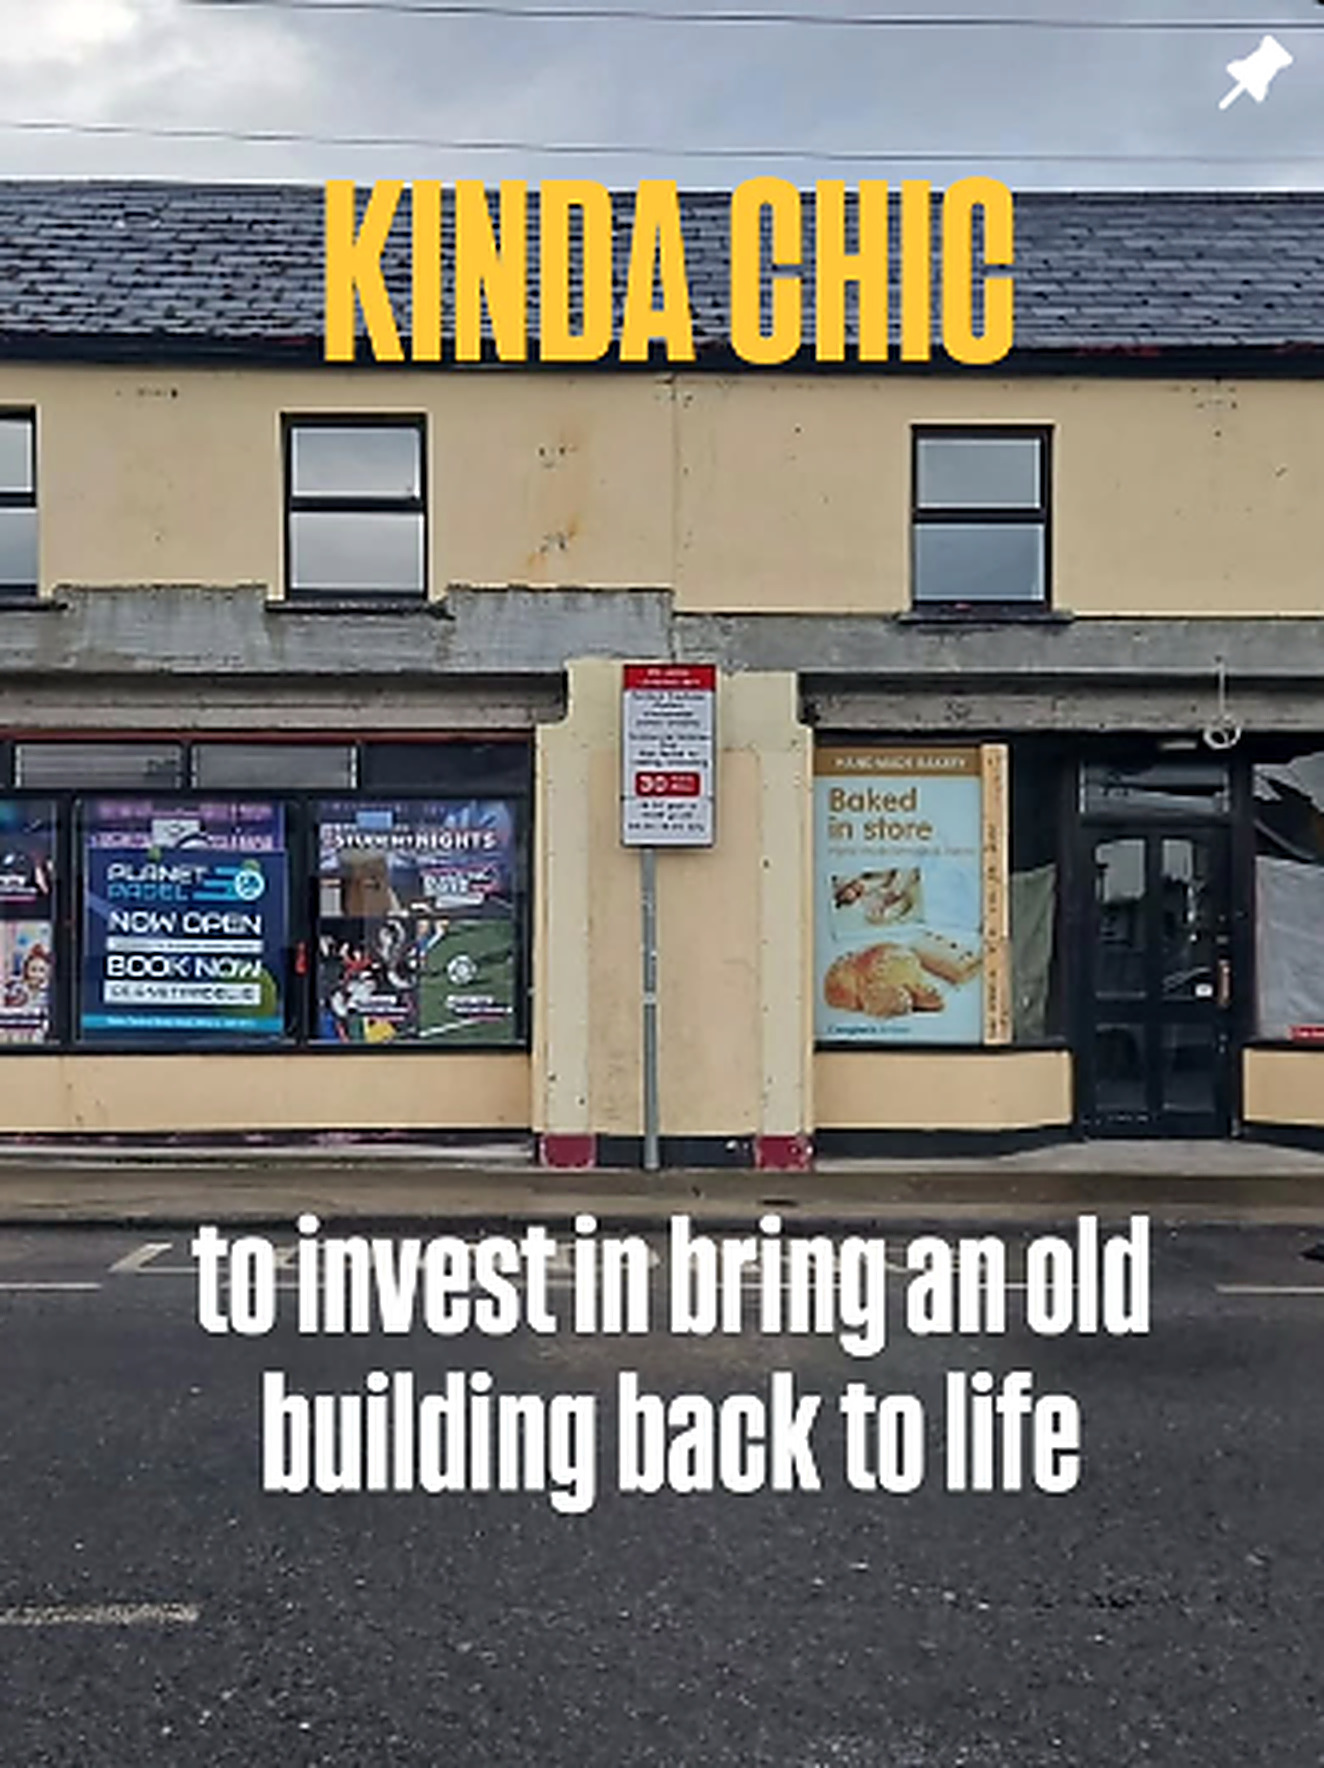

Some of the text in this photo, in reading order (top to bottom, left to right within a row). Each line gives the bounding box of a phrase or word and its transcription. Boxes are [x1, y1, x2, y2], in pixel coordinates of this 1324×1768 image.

[828, 787, 918, 812] Baked
[828, 816, 933, 841] in store
[415, 832, 497, 849] NIGHTS
[106, 863, 208, 884] PLANET
[108, 911, 262, 935] NOW OPEN
[106, 955, 262, 978] BOOK NOW
